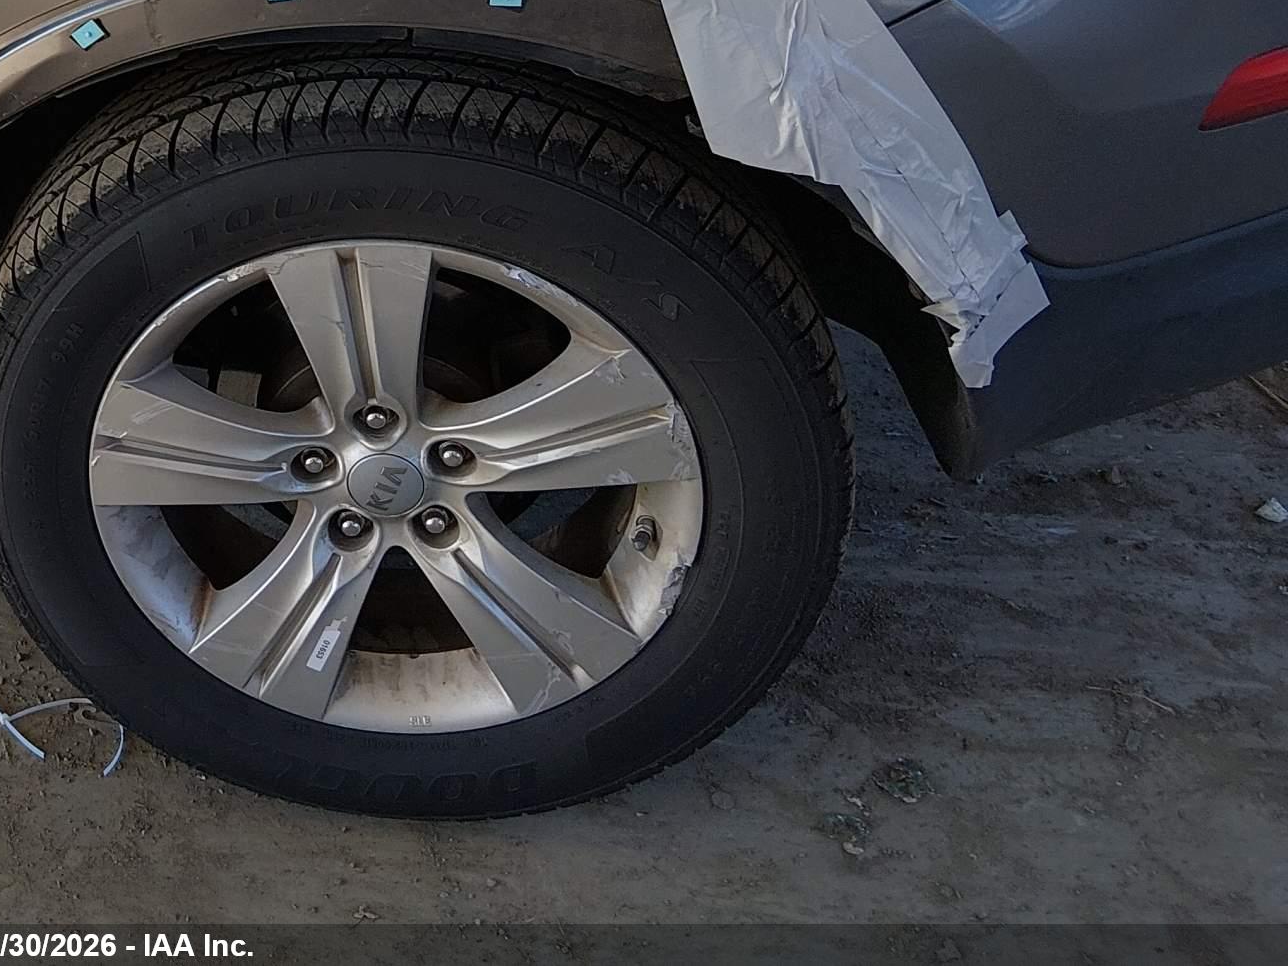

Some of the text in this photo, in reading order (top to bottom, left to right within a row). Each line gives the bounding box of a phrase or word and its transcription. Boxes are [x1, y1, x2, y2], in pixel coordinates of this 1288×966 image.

[184, 187, 692, 322] TOURING A/S
[53, 321, 85, 363] 99H
[367, 466, 408, 511] KIA
